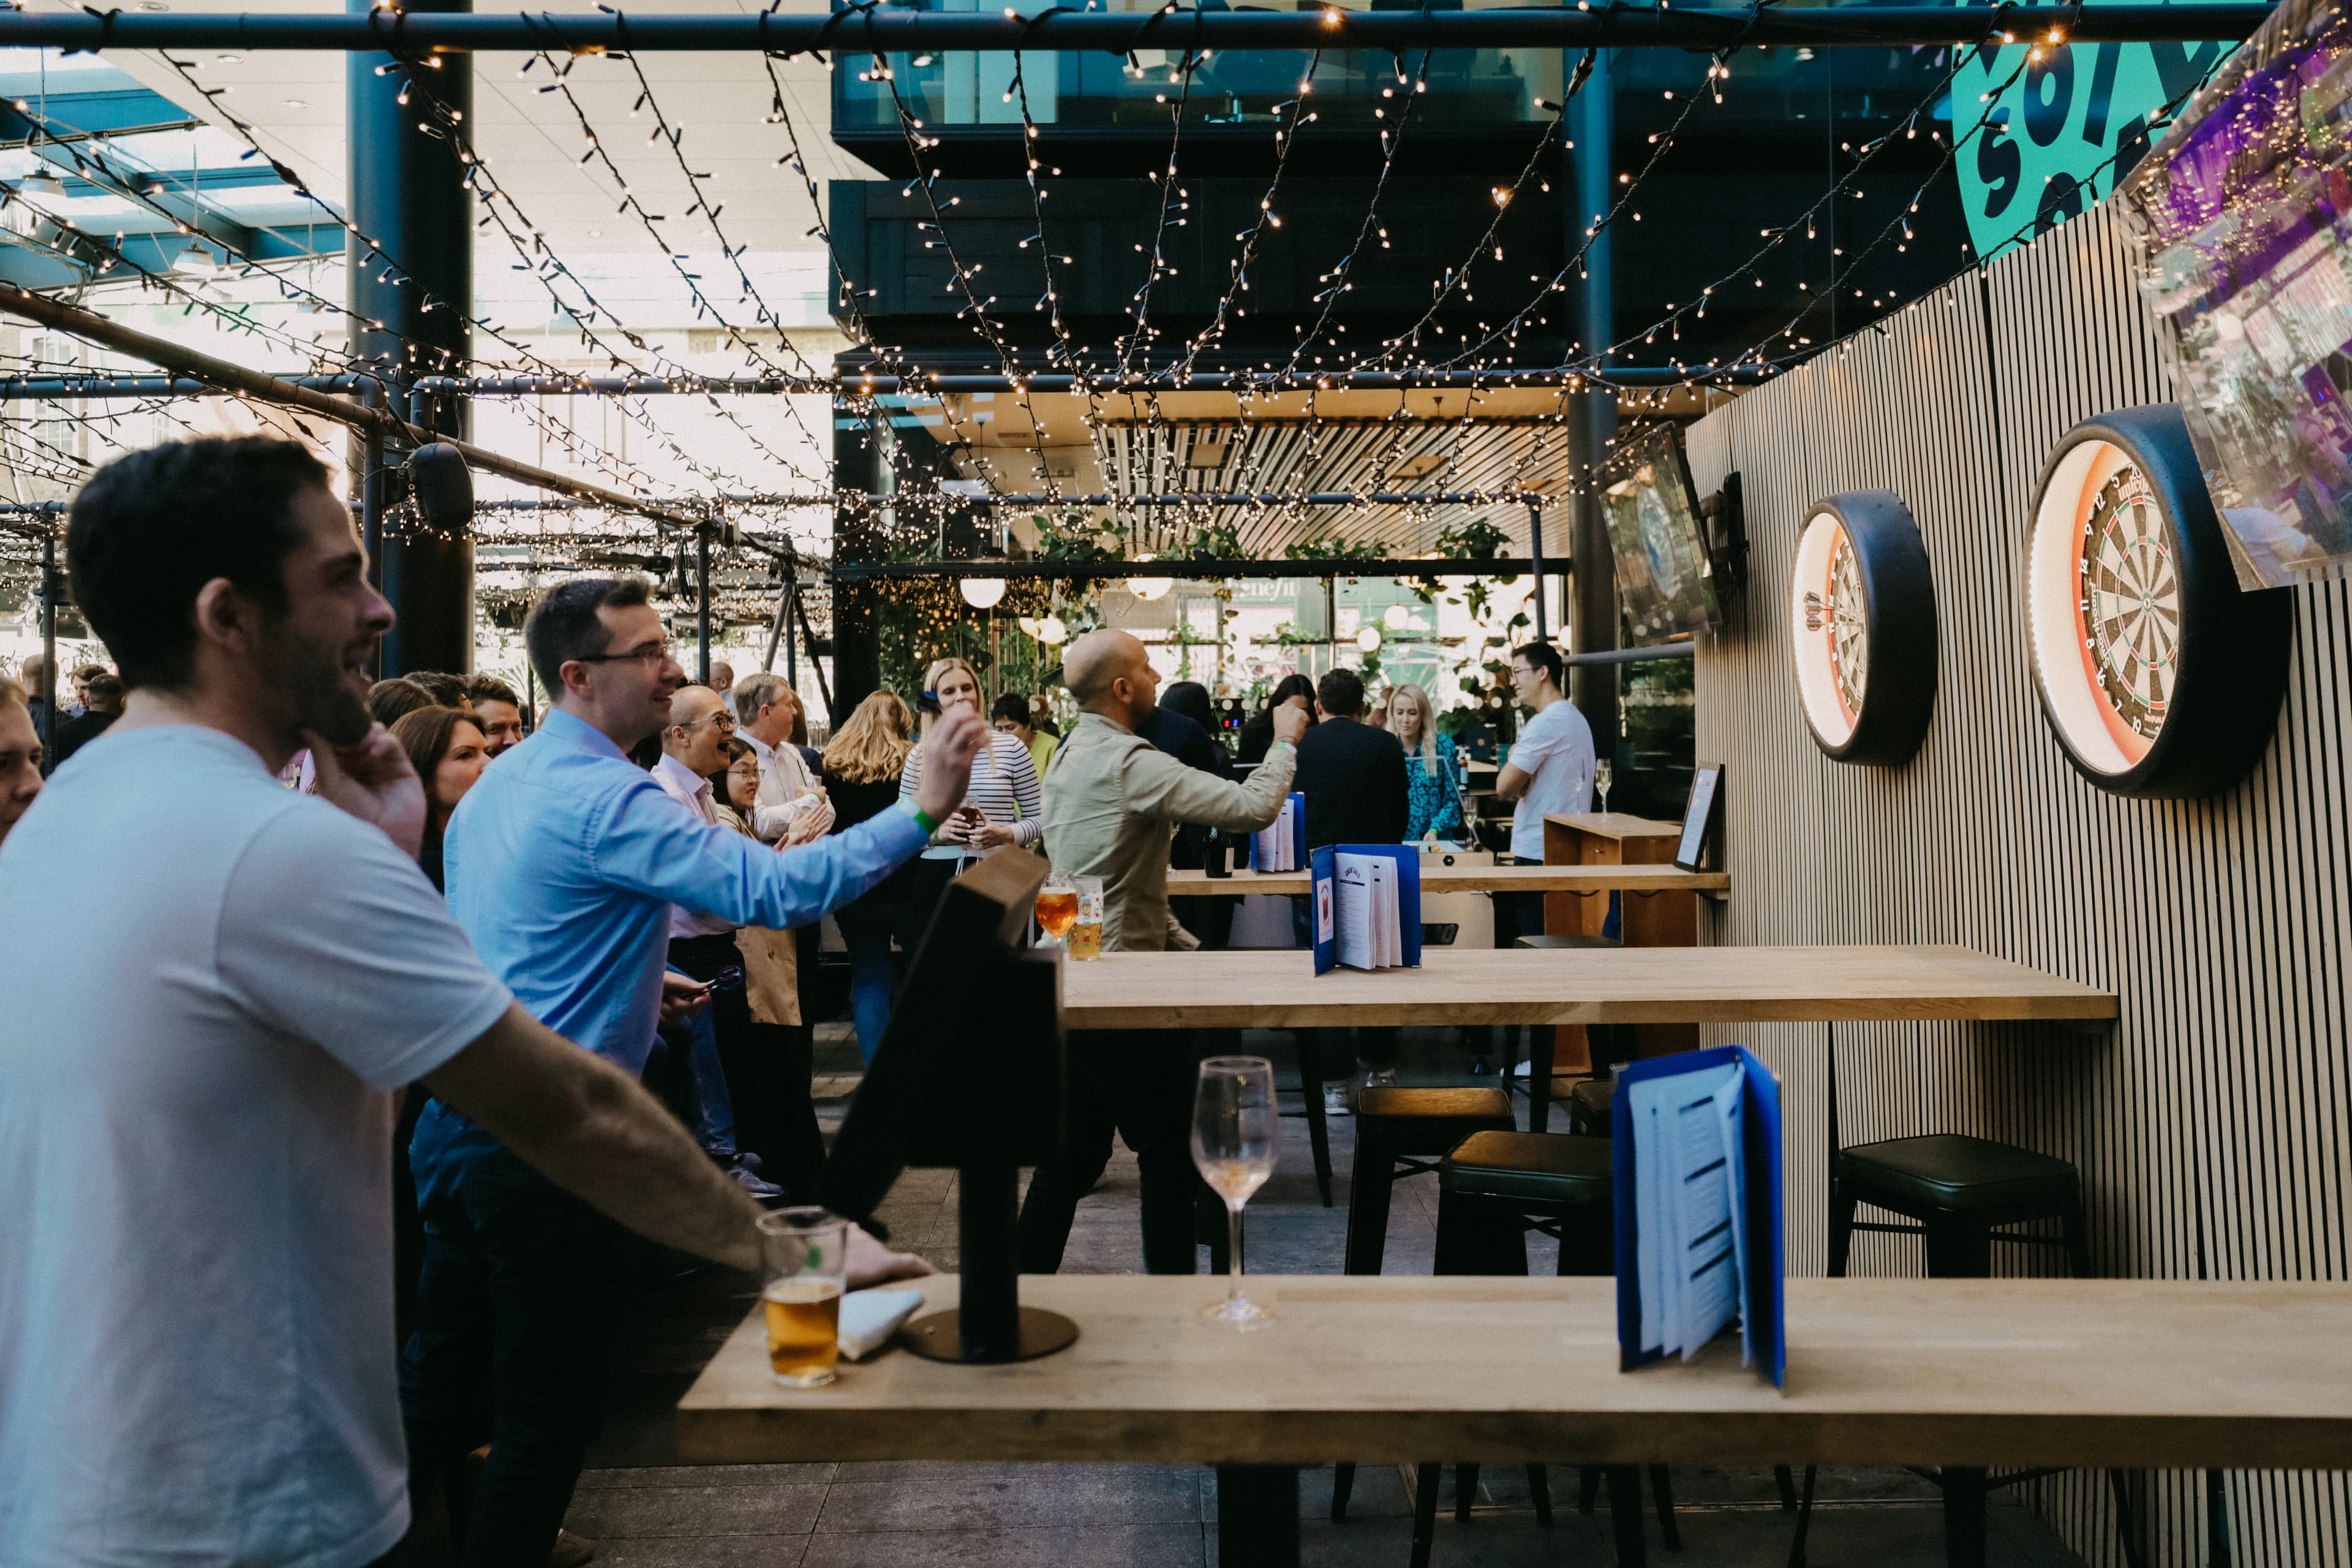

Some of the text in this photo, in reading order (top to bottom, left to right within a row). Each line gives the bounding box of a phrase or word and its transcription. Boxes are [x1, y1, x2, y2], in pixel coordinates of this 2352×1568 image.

[2128, 463, 2143, 480] 20
[2111, 472, 2120, 489] 5
[2117, 477, 2150, 501] unicor
[2094, 492, 2106, 511] 12
[2084, 523, 2094, 536] 9
[2079, 558, 2089, 575] 14
[2079, 600, 2089, 611] 11
[2089, 581, 2111, 669] Smartboard
[2086, 639, 2095, 650] 8
[2096, 666, 2106, 687] 16
[2115, 698, 2123, 712] 7
[2132, 716, 2142, 735] 19
